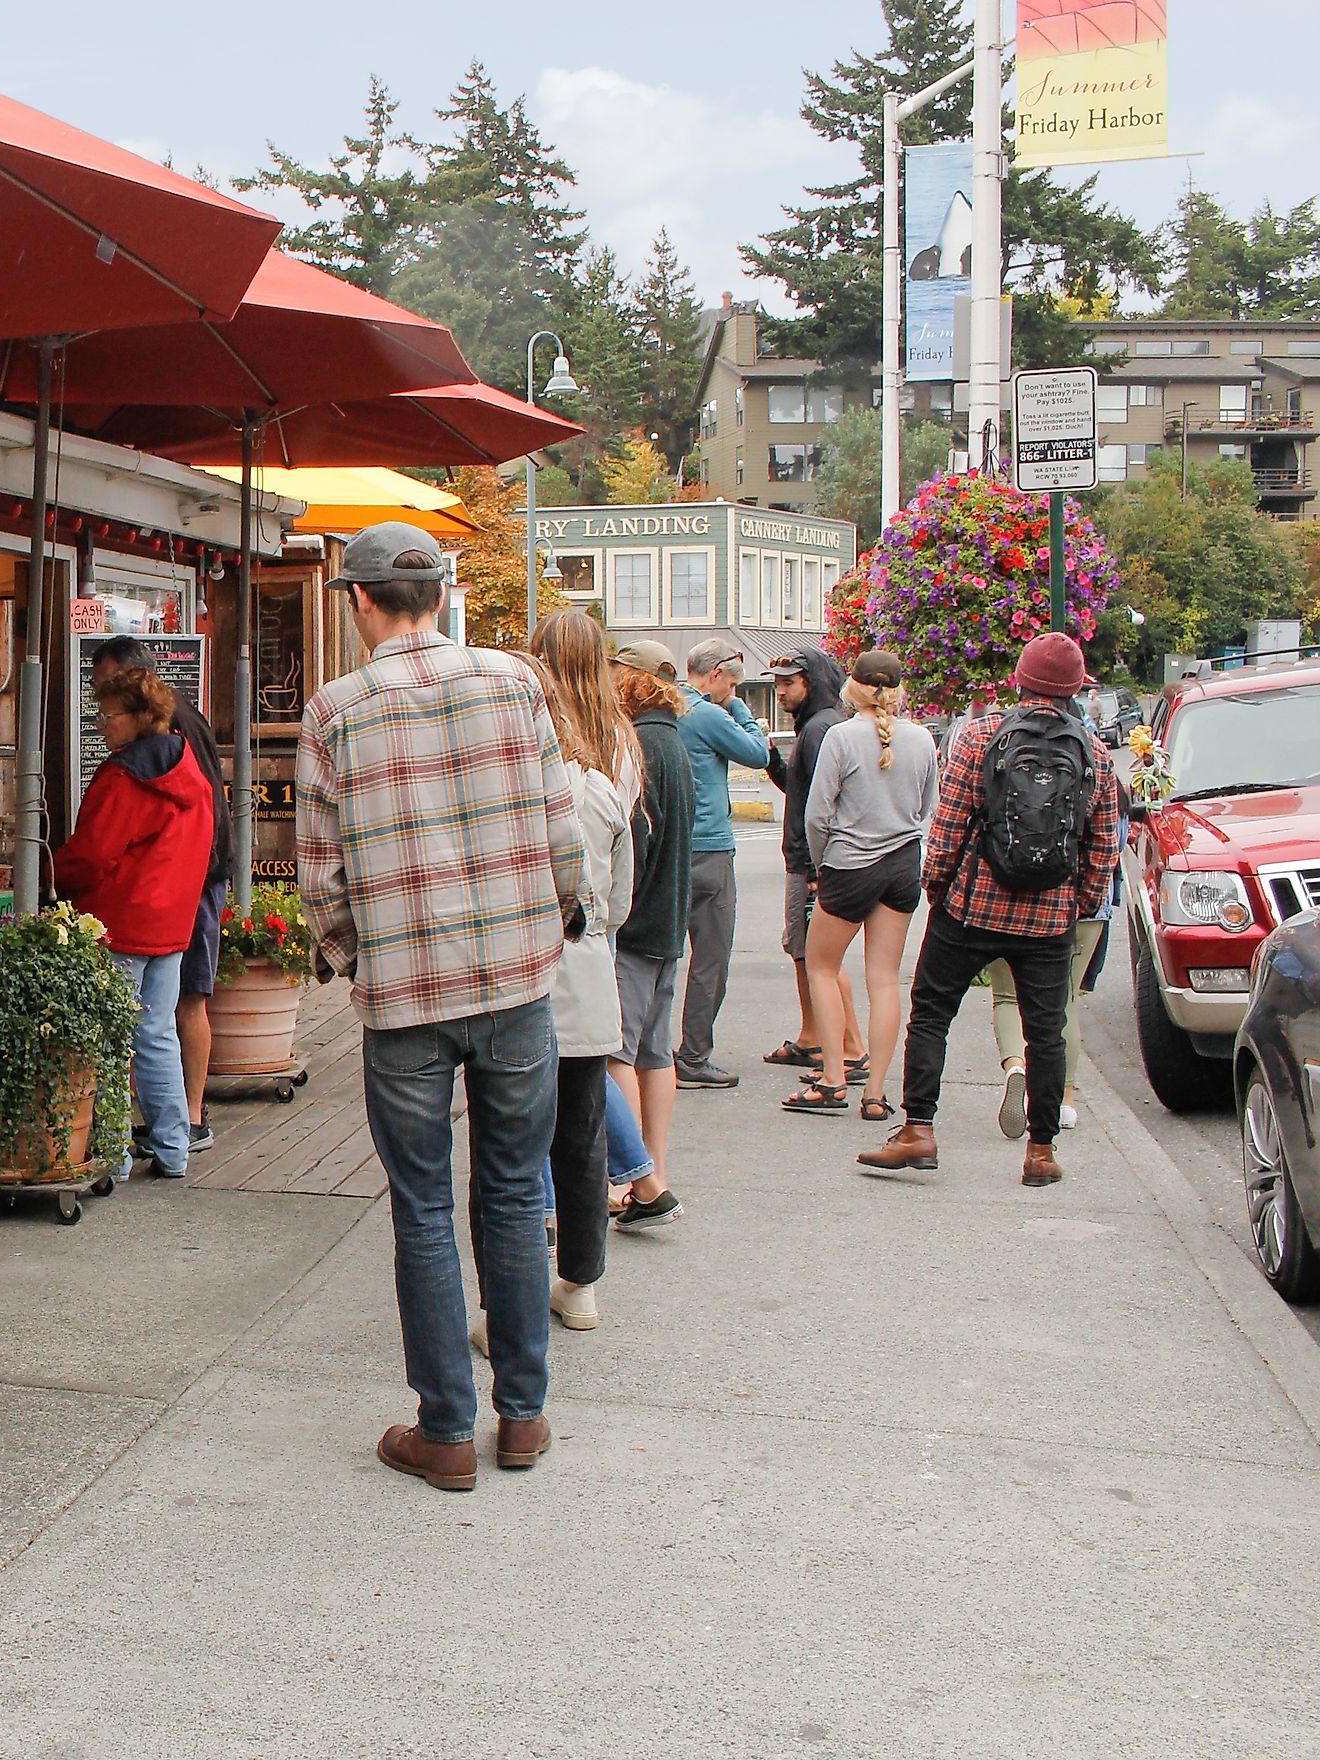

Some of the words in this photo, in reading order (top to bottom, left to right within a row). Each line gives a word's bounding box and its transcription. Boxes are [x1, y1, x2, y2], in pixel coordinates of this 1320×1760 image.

[1020, 70, 1161, 107] Summer
[1018, 113, 1079, 139] Friday
[1088, 107, 1164, 130] Harbor
[909, 347, 944, 364] Friday
[1040, 389, 1070, 397] ashtray?
[1051, 397, 1073, 405] $1025
[1020, 442, 1049, 452] REPORT
[1051, 440, 1093, 450] VIOLATORS
[1020, 450, 1045, 461] 866-
[1047, 447, 1093, 459] LITTER-1
[582, 515, 711, 539] LANDING
[740, 518, 792, 542] CANNERY
[795, 526, 840, 550] LANDING
[74, 604, 103, 617] CASH
[73, 618, 100, 630] ONLY
[282, 784, 294, 803] 1
[252, 860, 296, 877] ACCESS
